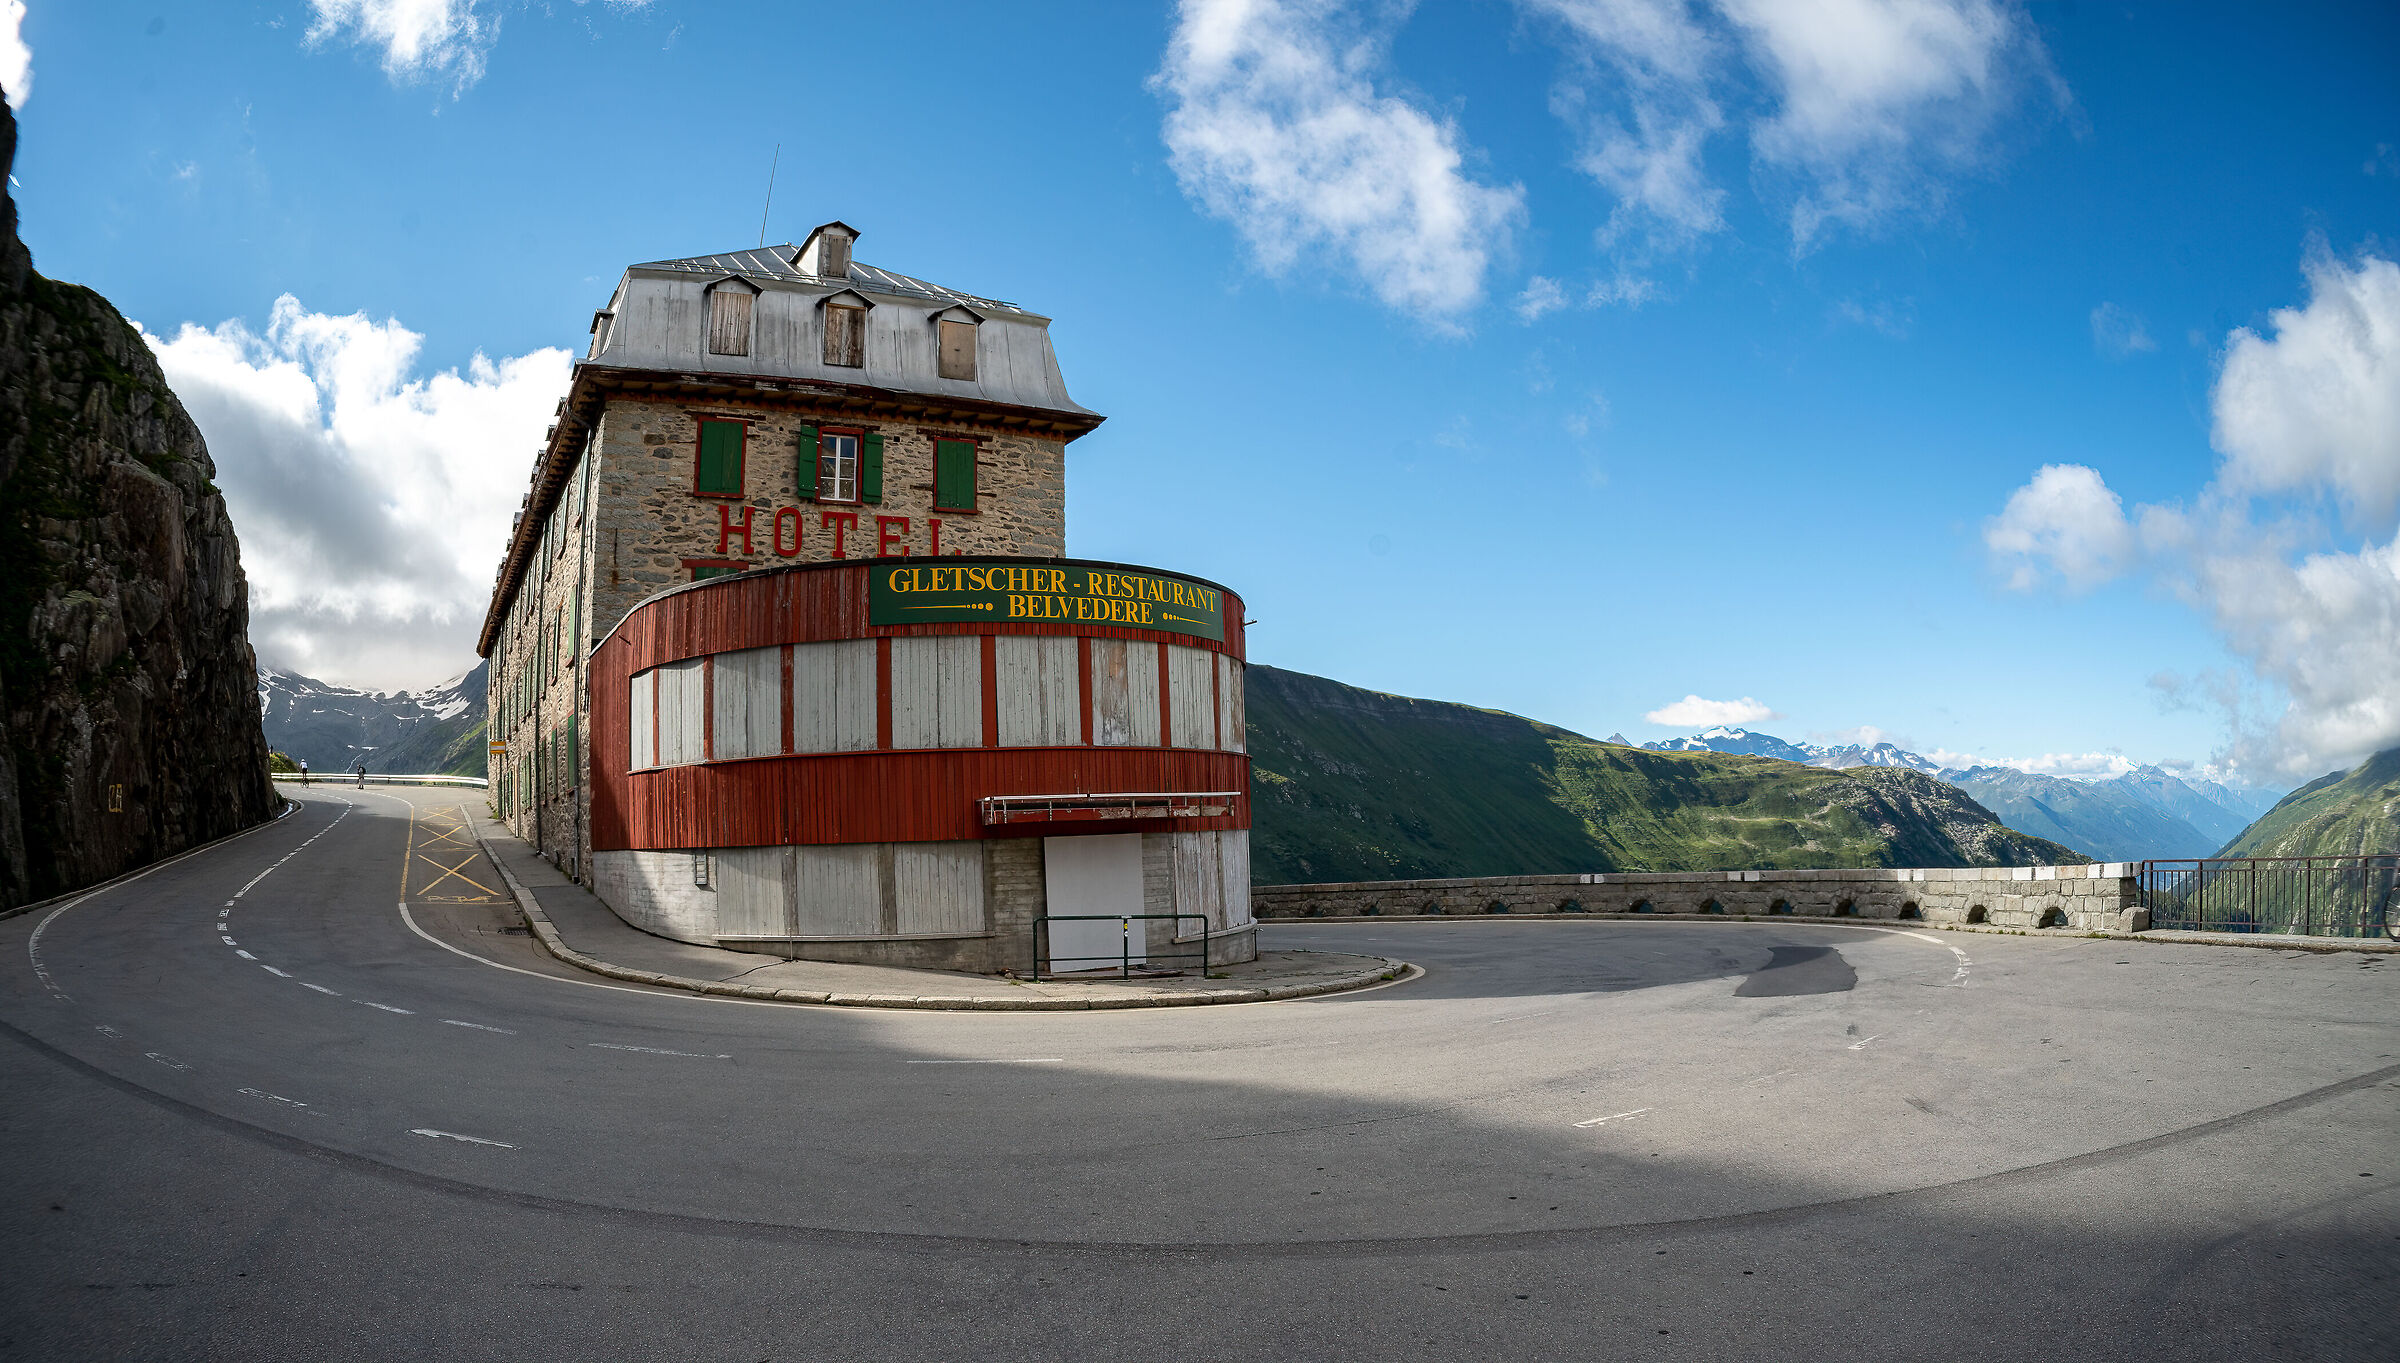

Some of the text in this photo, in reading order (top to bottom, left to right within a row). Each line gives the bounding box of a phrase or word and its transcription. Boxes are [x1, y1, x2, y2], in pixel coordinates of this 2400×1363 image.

[717, 504, 962, 558] HOTEL
[888, 567, 1068, 593] GLETSCHER
[1087, 572, 1217, 613] RESTAURANT
[1007, 594, 1154, 625] BELVEDERE
